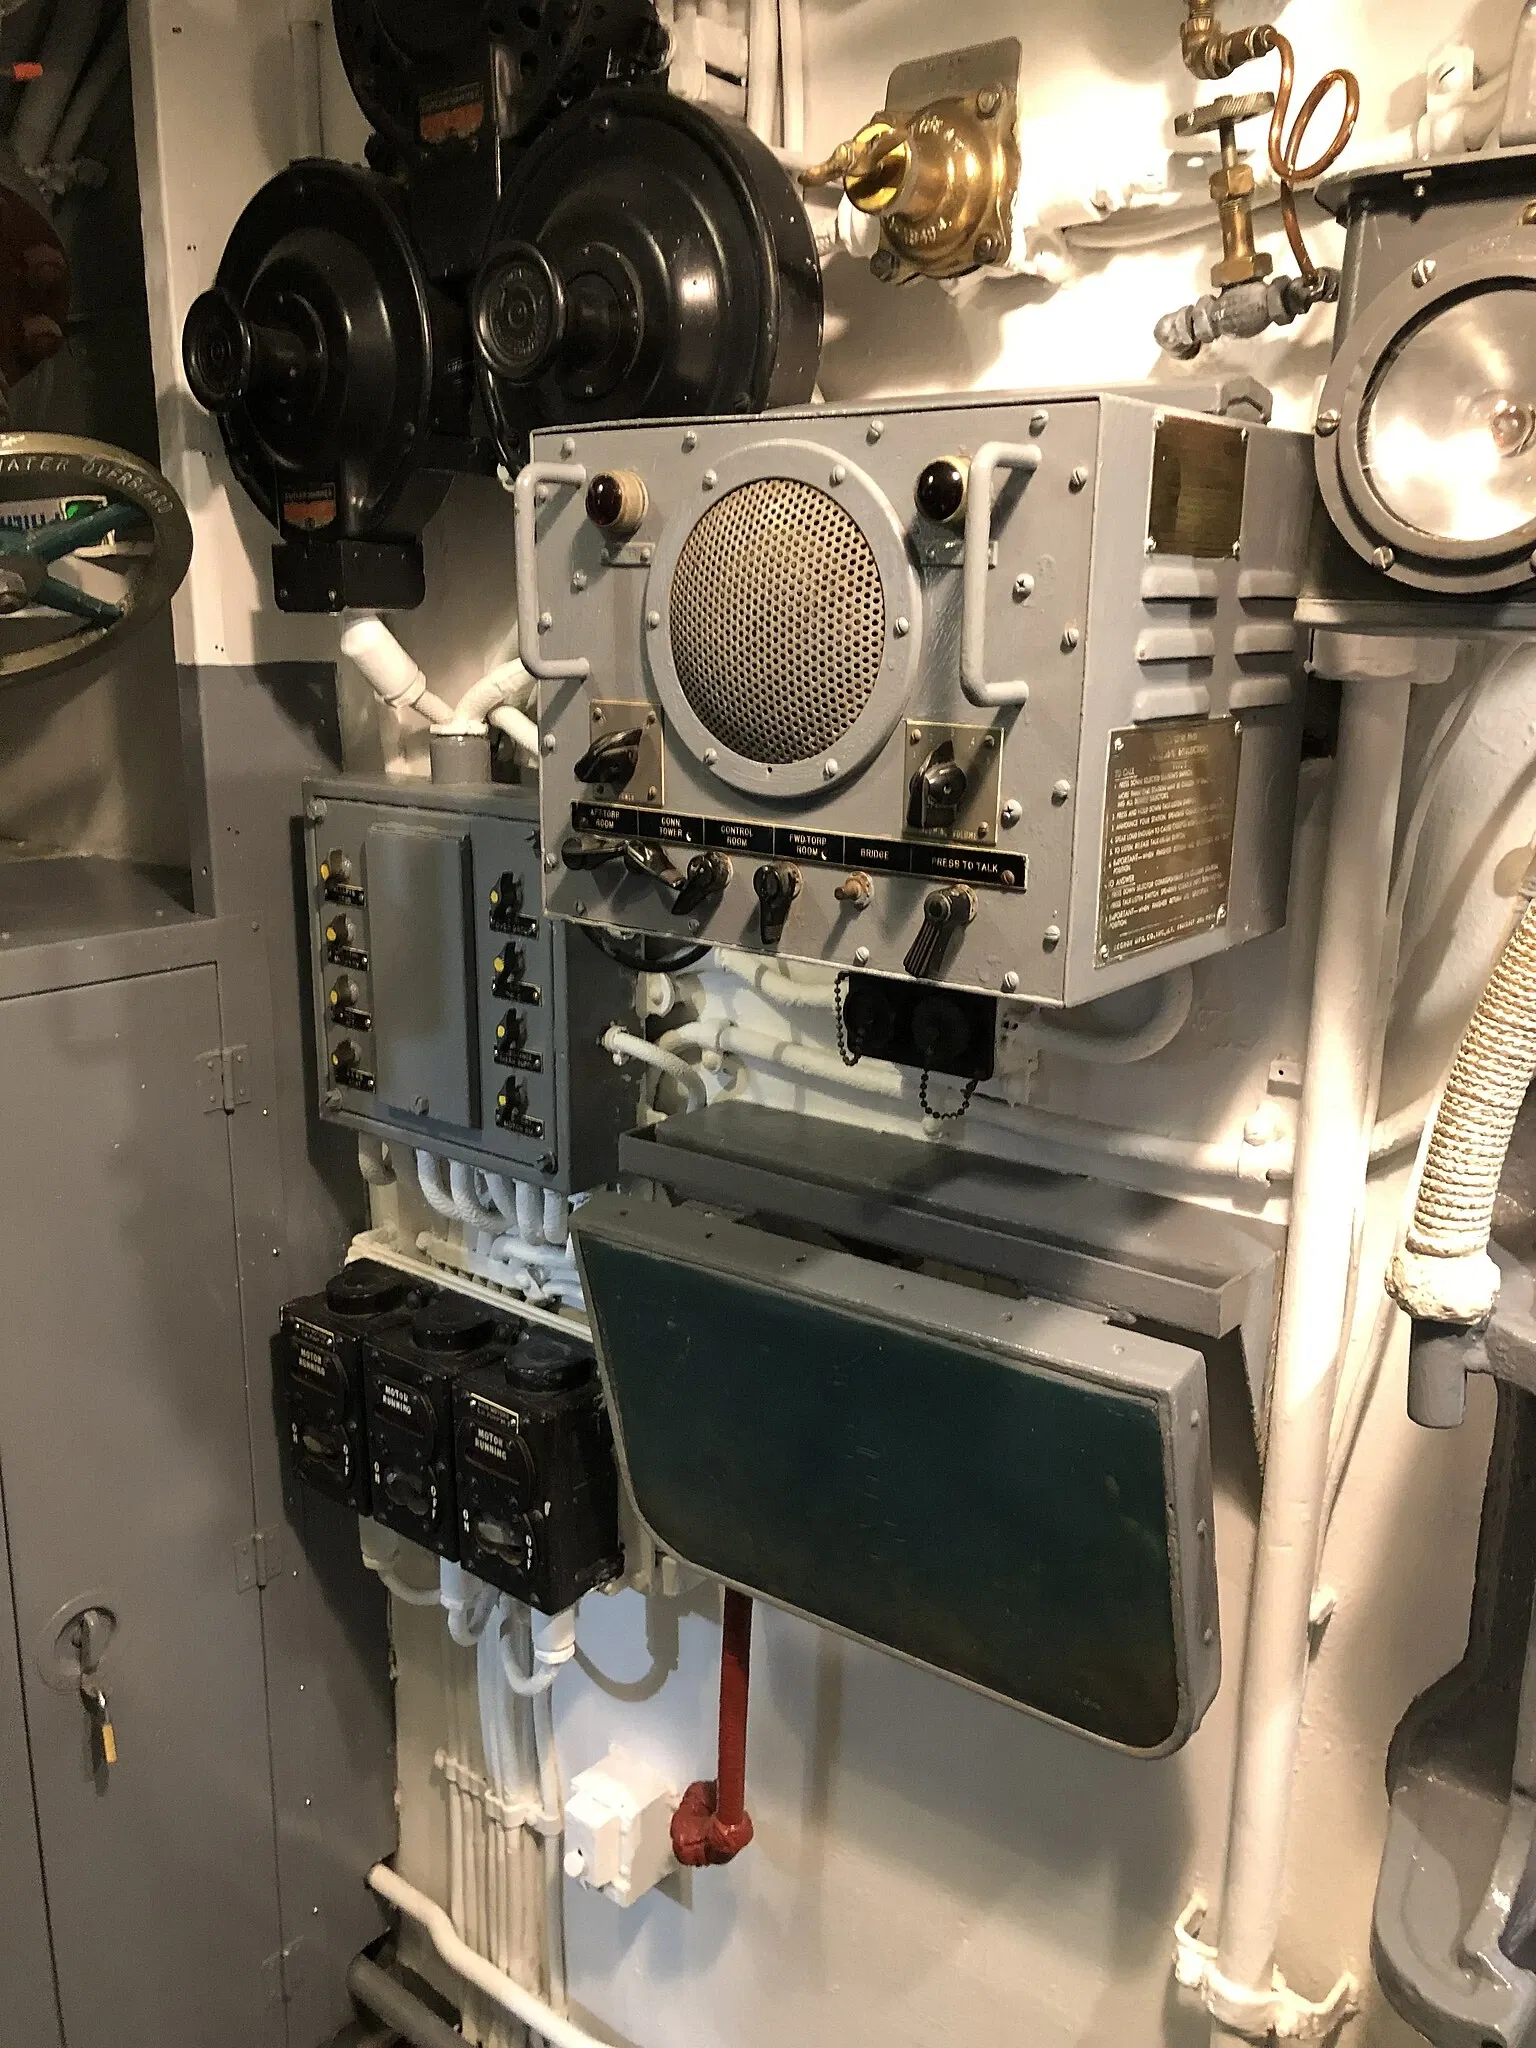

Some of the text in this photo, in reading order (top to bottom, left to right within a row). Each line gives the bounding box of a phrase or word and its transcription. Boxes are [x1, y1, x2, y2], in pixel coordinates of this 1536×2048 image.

[595, 818, 614, 829] ROOM
[659, 826, 683, 838] TOWER
[720, 825, 754, 838] CONTROL
[726, 836, 748, 847] ROOM
[796, 845, 818, 856] ROOM
[860, 847, 890, 860] BRIDGE
[931, 856, 999, 874] PRESS TO TALK
[300, 1347, 322, 1365] MOTOR
[298, 1356, 326, 1377] RUNNING
[385, 1384, 409, 1403] MOTOR
[382, 1393, 412, 1416] RUNNING
[291, 1422, 299, 1444] ON
[477, 1427, 504, 1449] MOTOR
[474, 1436, 507, 1461] RUNNING
[373, 1460, 381, 1485] ON
[462, 1508, 470, 1533] ON
